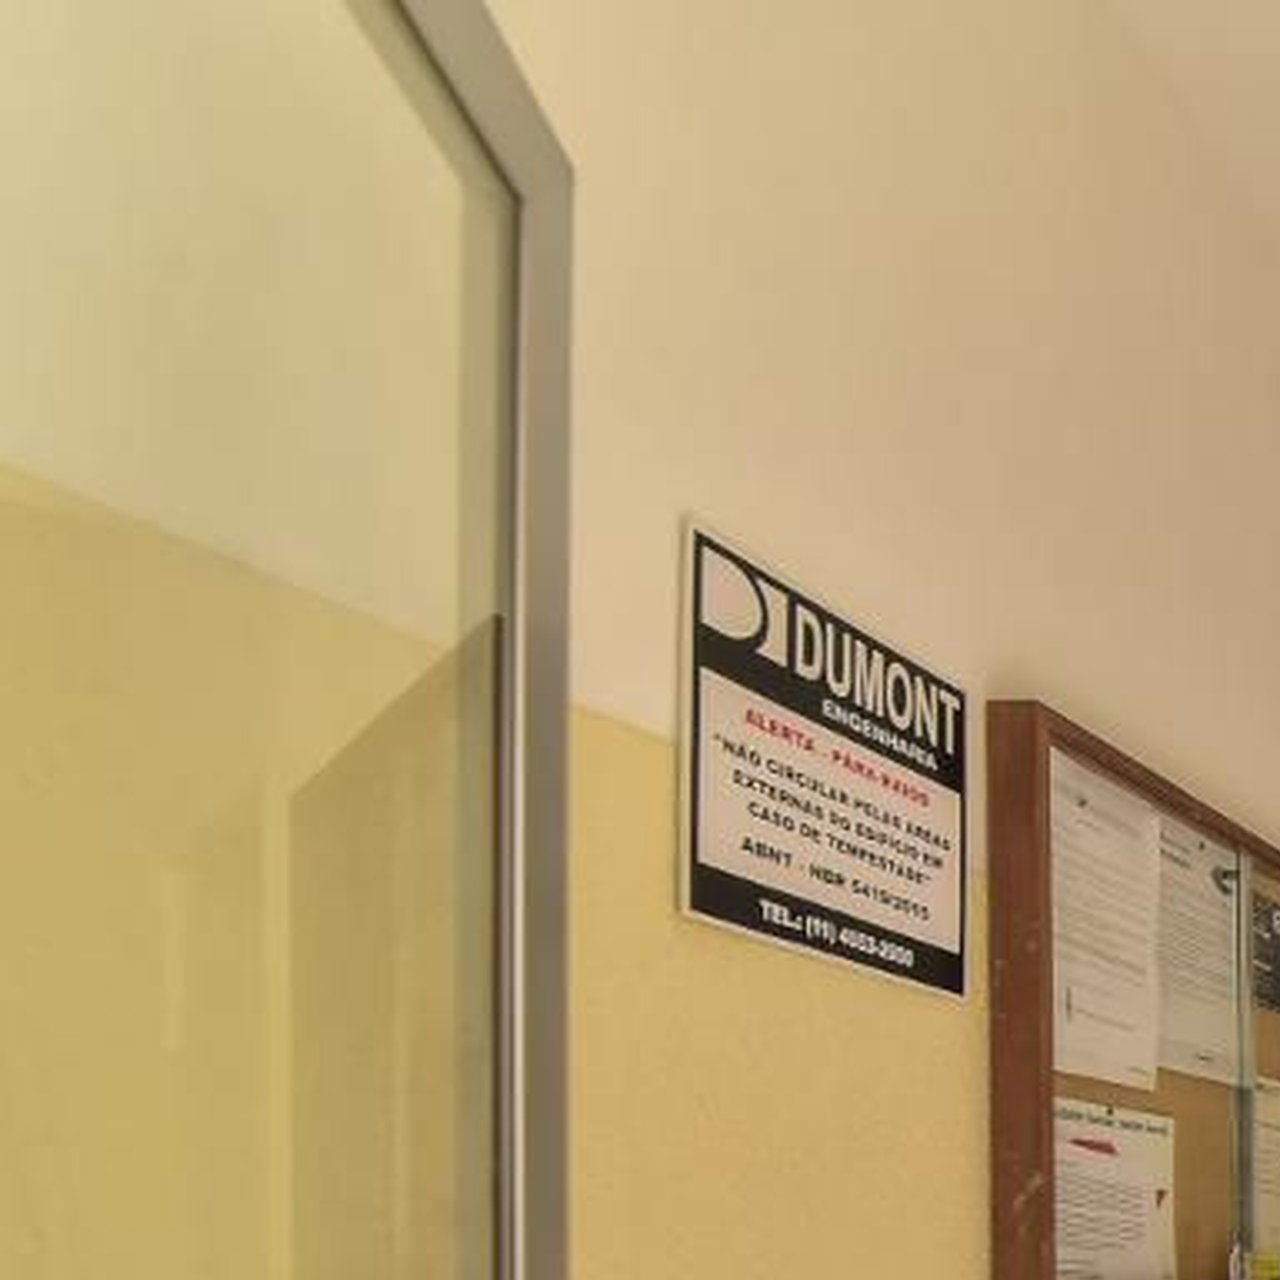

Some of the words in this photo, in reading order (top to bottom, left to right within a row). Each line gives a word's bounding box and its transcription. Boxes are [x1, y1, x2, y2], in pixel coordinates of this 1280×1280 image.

[796, 601, 961, 755] DUMONT
[745, 708, 815, 752] ALERTA
[821, 699, 939, 772] ENGENHARIA
[732, 768, 825, 821] EXTERNAS
[829, 810, 851, 832] DO
[765, 757, 849, 805] CIRCULAR
[748, 801, 795, 832] CASO
[799, 822, 821, 845] DE
[741, 836, 792, 869] ABNT
